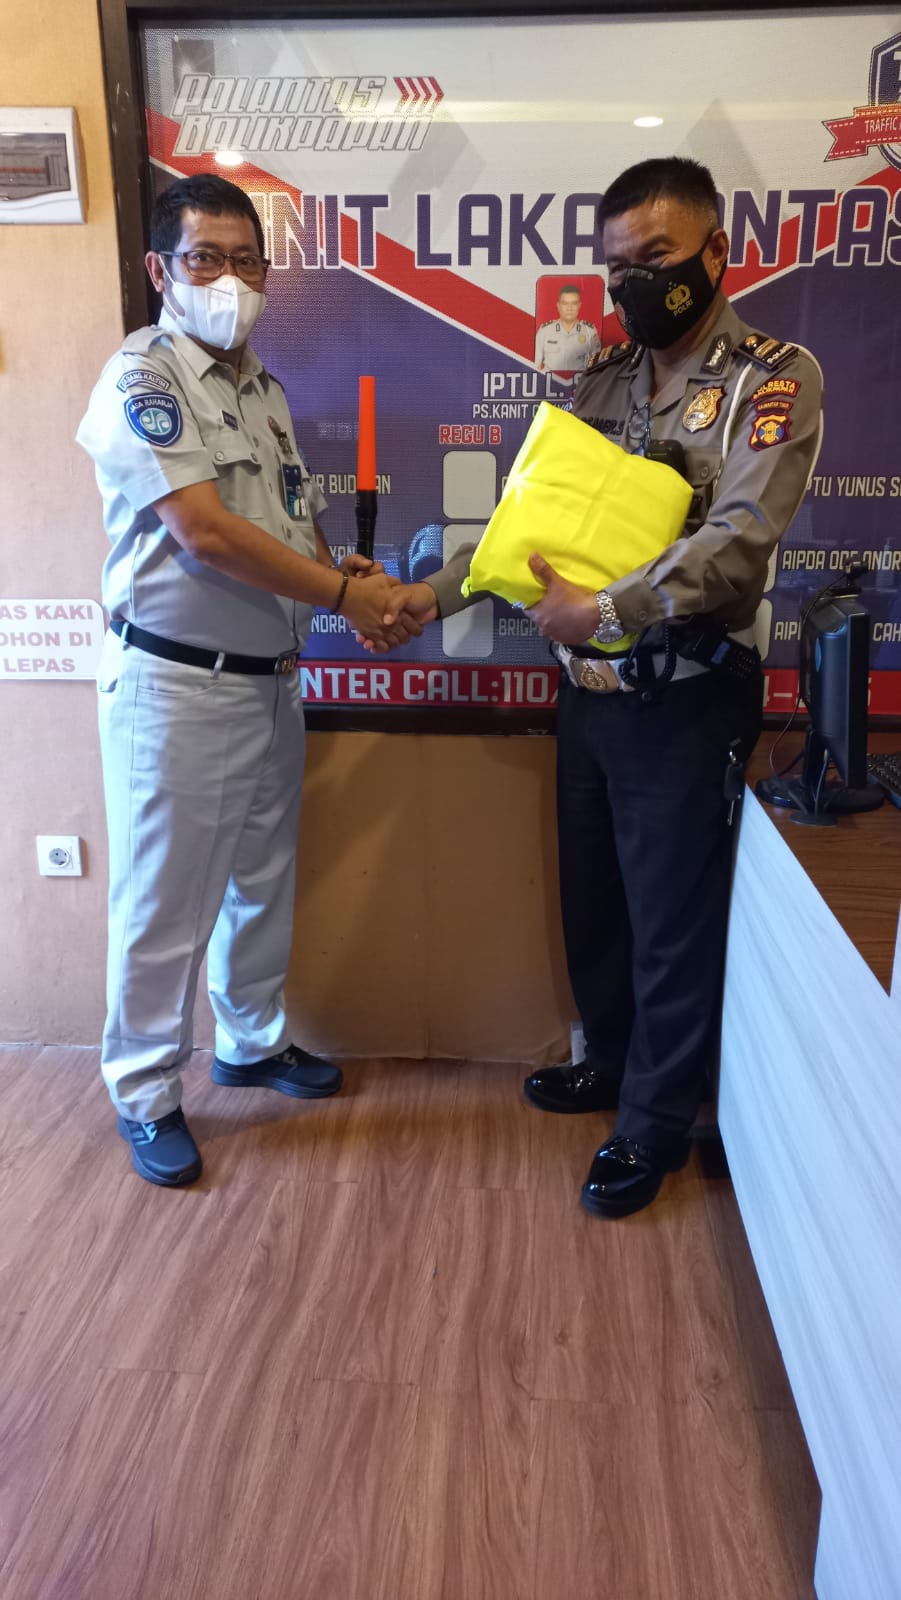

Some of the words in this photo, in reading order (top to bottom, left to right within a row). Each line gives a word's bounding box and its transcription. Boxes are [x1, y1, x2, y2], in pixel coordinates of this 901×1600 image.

[864, 117, 897, 134] TRAFFIC
[673, 299, 694, 317] POLRI
[483, 373, 537, 397] IPTU
[473, 404, 528, 419] PS.KANIT
[439, 425, 485, 444] REGU
[489, 425, 501, 444] B
[837, 477, 886, 496] YUNUS
[782, 550, 826, 570] AIPDA
[35, 605, 94, 620] KAKI
[69, 632, 92, 647] DI
[774, 621, 800, 640] AIP
[4, 658, 76, 673] LEPAS
